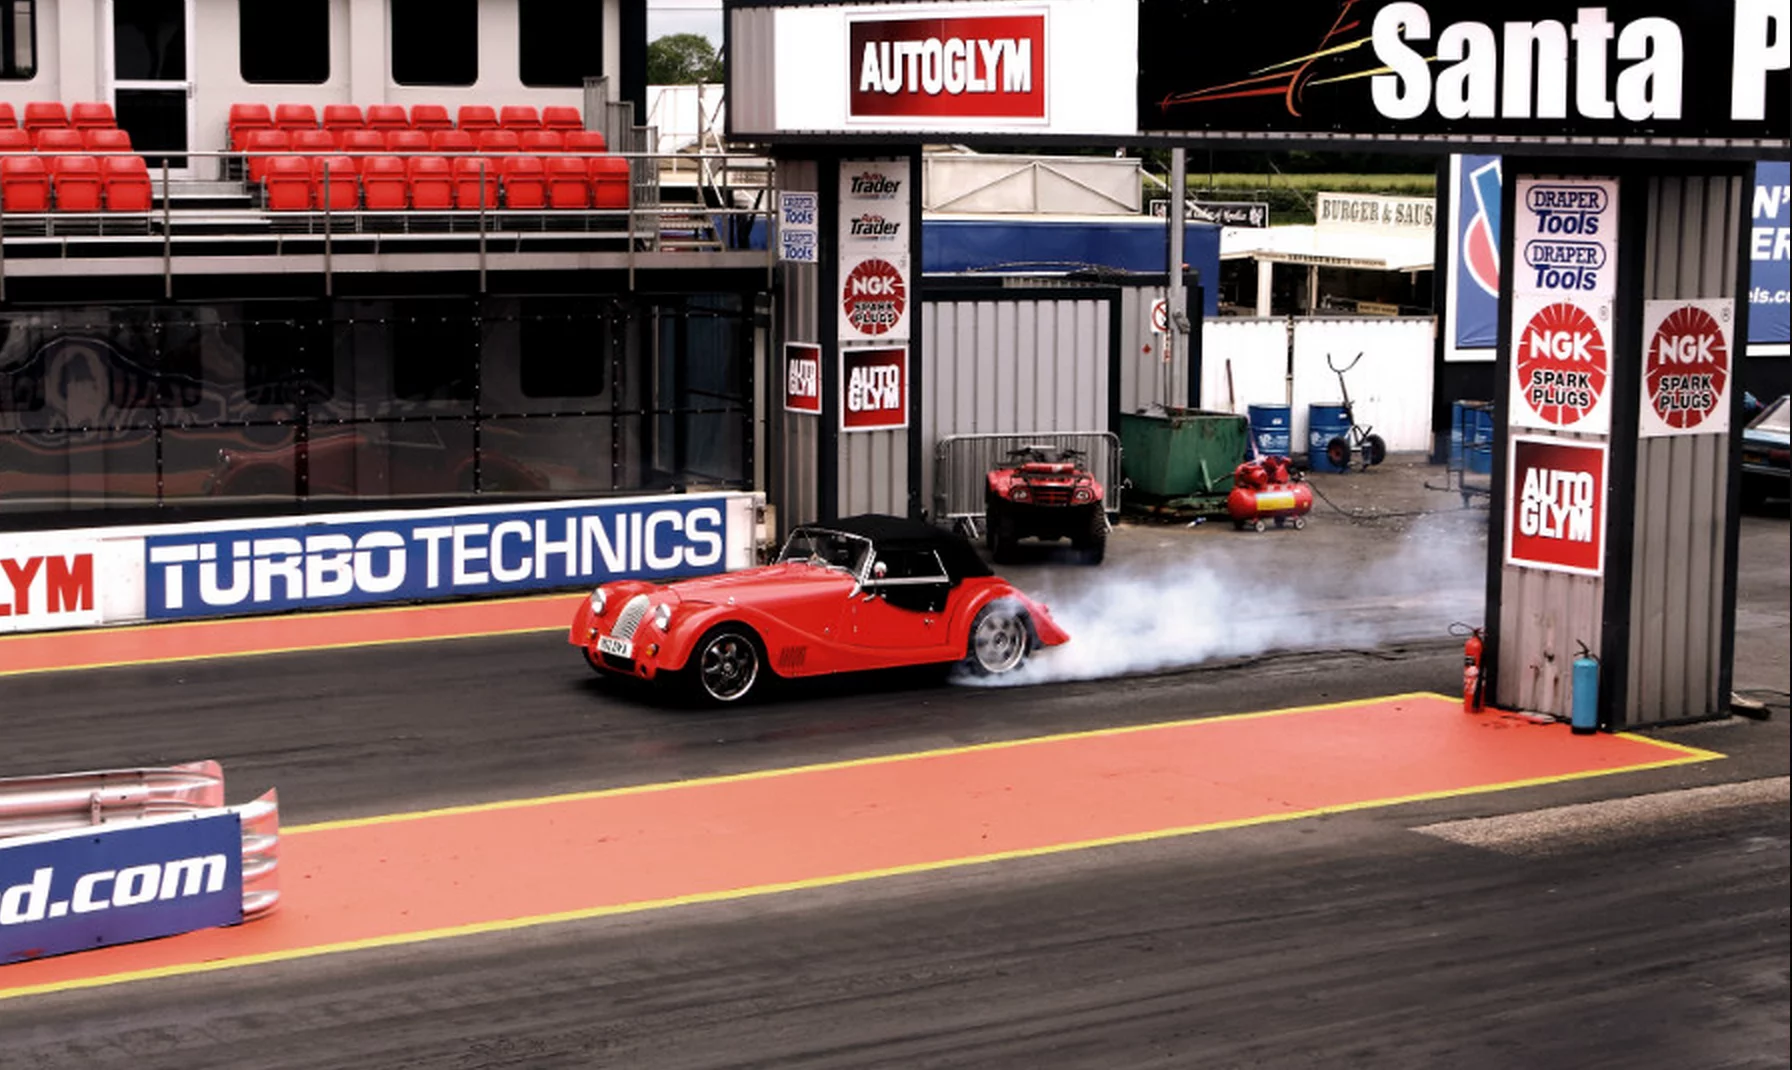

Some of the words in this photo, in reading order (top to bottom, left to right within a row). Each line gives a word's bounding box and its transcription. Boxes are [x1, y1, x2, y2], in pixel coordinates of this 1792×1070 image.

[859, 38, 1032, 94] AUTOGLYM
[1371, 1, 1683, 121] Santa
[851, 176, 901, 193] Trader
[1533, 191, 1599, 209] DRAPER
[784, 208, 813, 224] Tools
[1322, 199, 1379, 222] BURGER
[1382, 203, 1392, 223] &
[1396, 204, 1435, 226] SAUS
[1536, 210, 1599, 235] Tools
[850, 218, 901, 235] Trader
[784, 244, 812, 260] Tools
[1532, 245, 1597, 264] DRAPER
[1751, 227, 1790, 260] ER
[852, 276, 896, 297] NGK
[1534, 264, 1597, 291] Tools
[855, 302, 894, 312] SPARK
[855, 313, 895, 324] PLUGS
[1530, 330, 1593, 363] NGK
[1658, 333, 1716, 365] NGK
[788, 359, 816, 380] AUTO
[850, 364, 900, 388] AUTO
[1533, 371, 1589, 388] SPARK
[1661, 376, 1711, 392] SPARK
[848, 385, 900, 412] GLYM
[1533, 390, 1589, 407] PLUGS
[1660, 394, 1711, 410] PLUGS
[1522, 467, 1594, 507] AUTO
[1520, 501, 1593, 542] GLYM
[150, 531, 406, 609] TURBO
[413, 507, 722, 588] TECHNICS
[0, 553, 94, 616] YM
[0, 854, 227, 925] d.com
